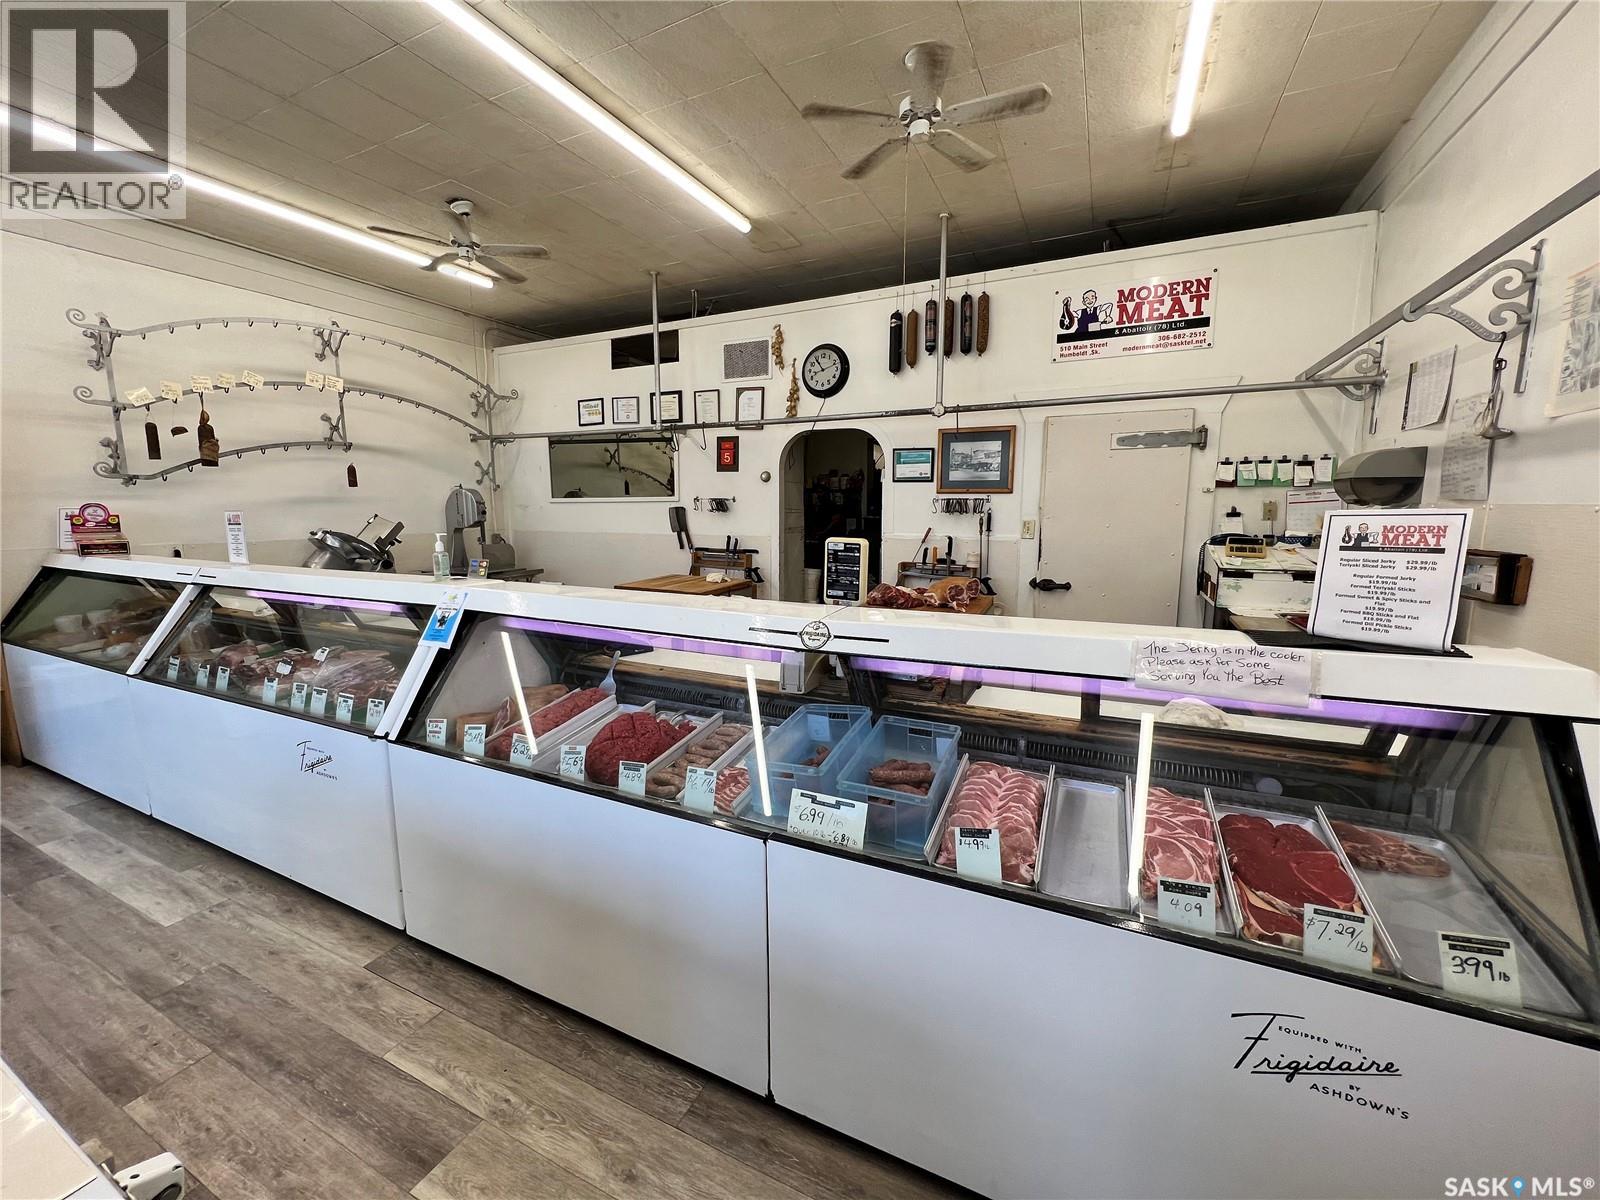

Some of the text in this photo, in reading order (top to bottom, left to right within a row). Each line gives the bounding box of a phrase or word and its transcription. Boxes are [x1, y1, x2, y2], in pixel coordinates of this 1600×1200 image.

[1117, 277, 1212, 303] MODERN
[1116, 293, 1210, 326] MEAT
[1122, 326, 1151, 334] Abattoir
[1154, 323, 1170, 332] (78)
[1158, 331, 1207, 342] 306-682-2512
[1089, 341, 1108, 349] Street
[1122, 338, 1207, 352] modernmeat@sasktel.net
[1060, 350, 1088, 358] Humboldt
[724, 452, 731, 463] 5
[1382, 525, 1448, 534] MODERN
[1380, 533, 1447, 547] MEAT
[1144, 640, 1170, 656] The
[1177, 642, 1217, 658] Jerky
[1222, 646, 1232, 654] is
[1234, 646, 1244, 655] in
[1246, 646, 1266, 658] the
[1146, 655, 1185, 666] Please
[1189, 656, 1211, 666] ask
[1216, 658, 1233, 667] for
[1149, 670, 1196, 684] Serving
[1202, 668, 1220, 682] You
[1251, 670, 1285, 686] Best
[297, 740, 333, 773] Frigidaire
[1452, 956, 1511, 982] 3.99 lb
[1278, 1026, 1362, 1053] EQUIPPED WITH
[1231, 1013, 1400, 1083] Frigidaire
[1349, 1084, 1360, 1092] BY
[1310, 1083, 1409, 1120] ASHDOWN'S
